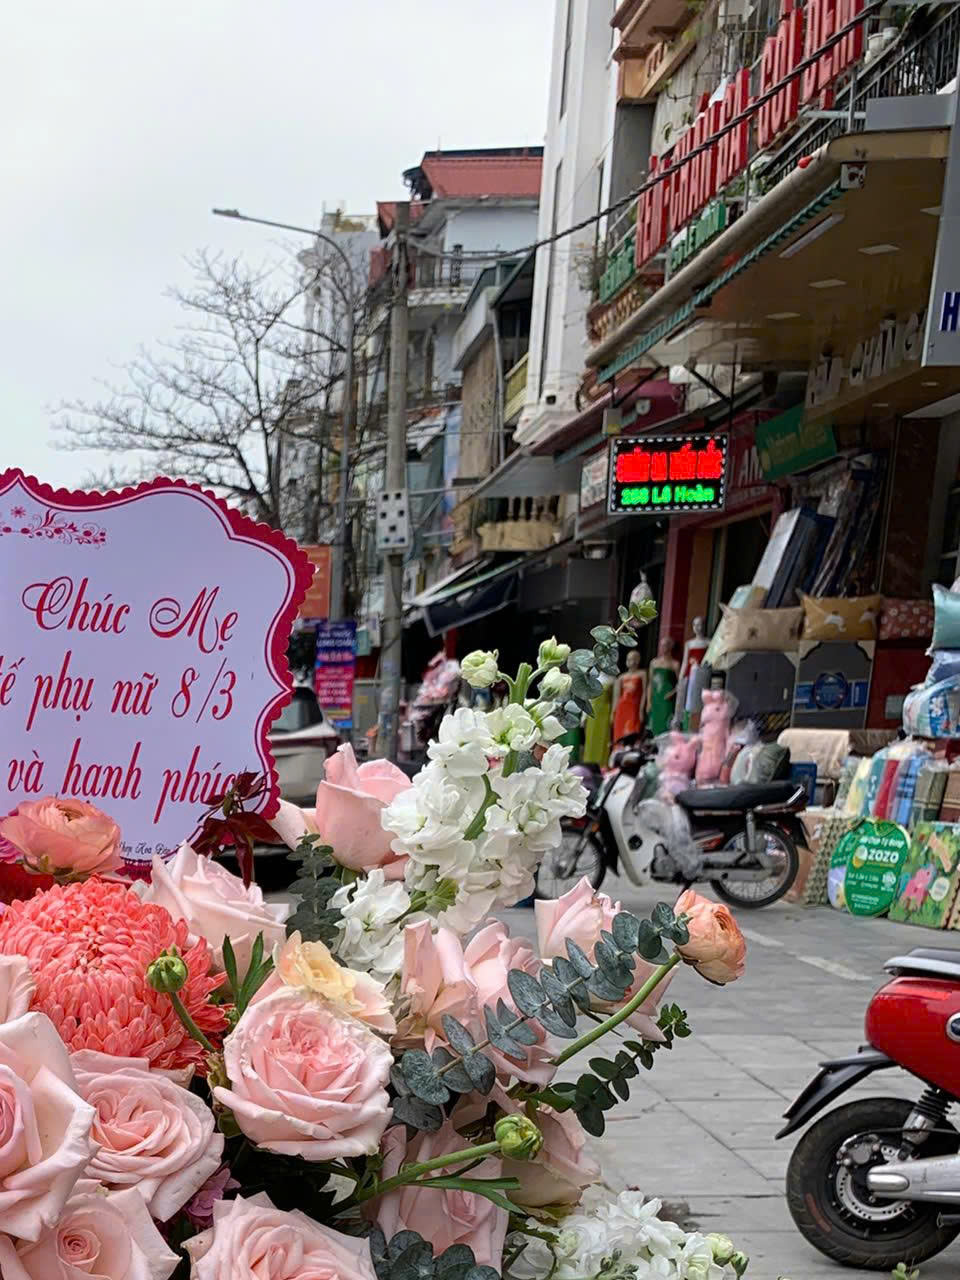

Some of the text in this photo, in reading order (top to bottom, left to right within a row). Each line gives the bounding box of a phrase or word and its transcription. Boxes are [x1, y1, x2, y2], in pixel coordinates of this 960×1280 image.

[21, 576, 131, 634] Chúc
[149, 586, 239, 654] Mẹ
[26, 650, 94, 731] phụ
[111, 672, 159, 716] nữ
[171, 658, 237, 724] 8/3
[7, 750, 45, 794] và
[868, 848, 899, 864] ZOZO
